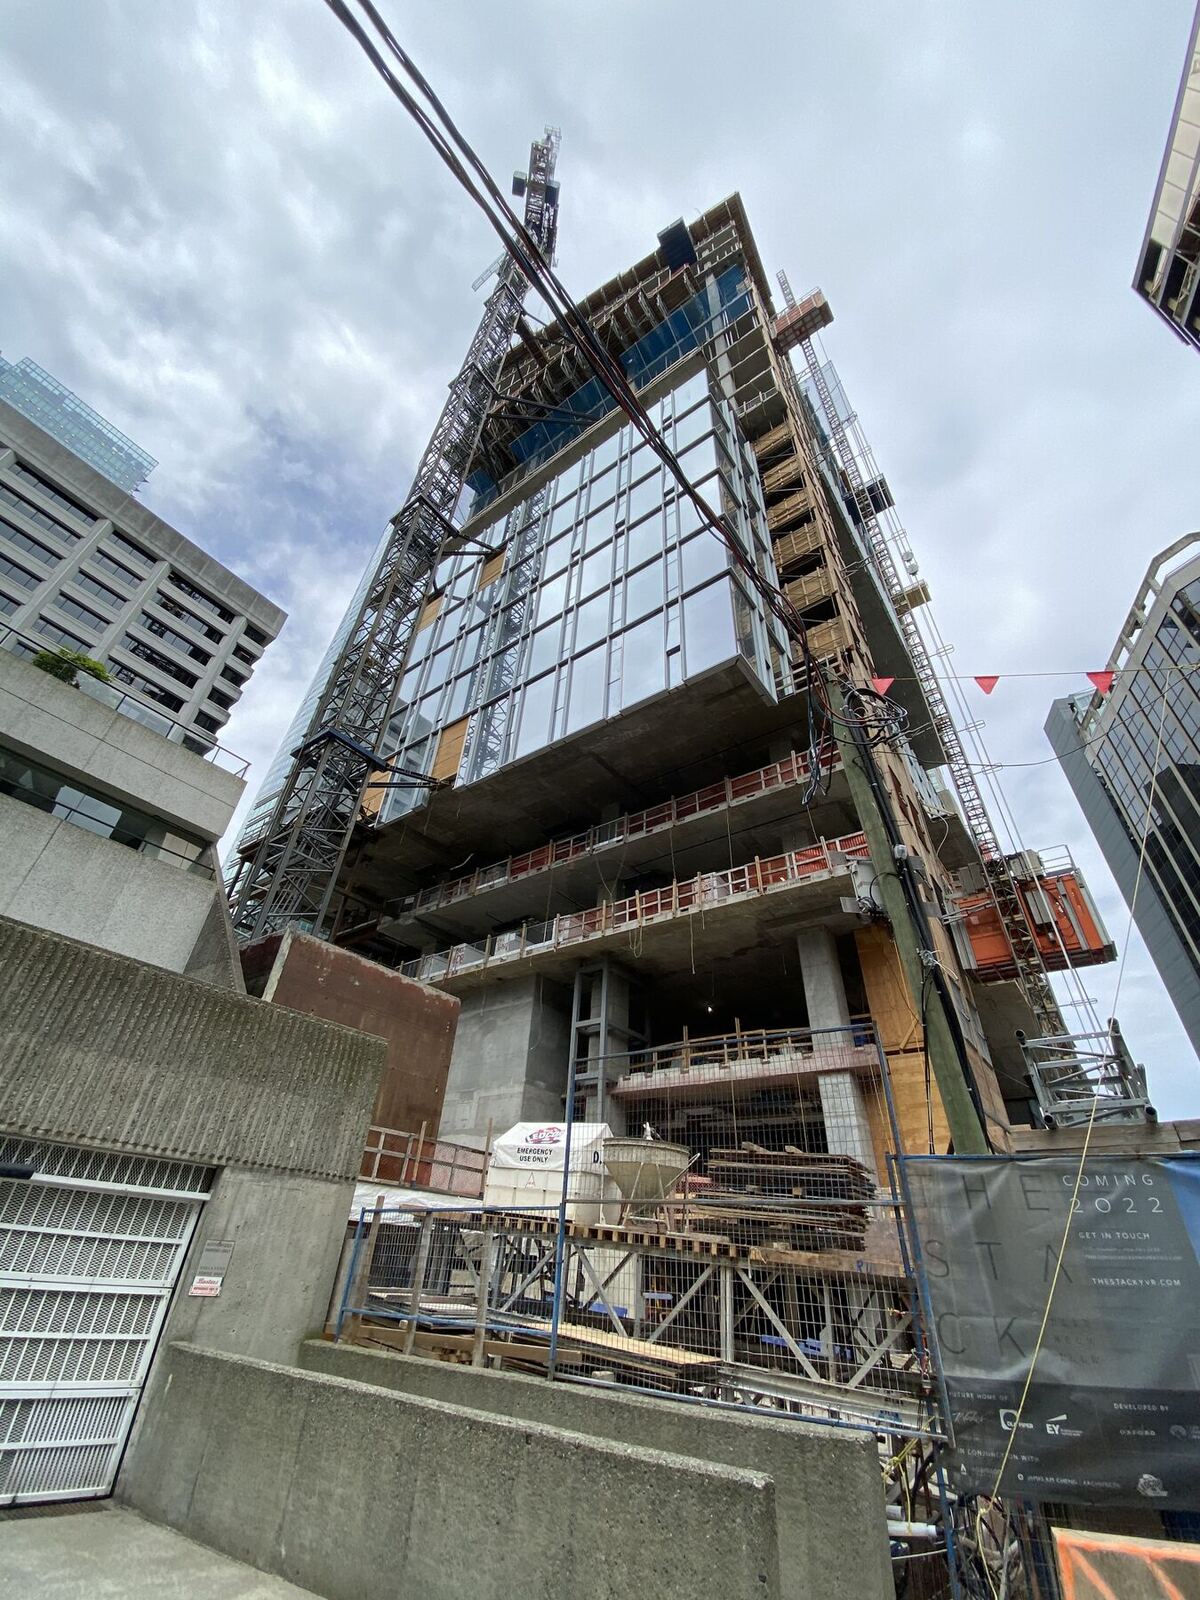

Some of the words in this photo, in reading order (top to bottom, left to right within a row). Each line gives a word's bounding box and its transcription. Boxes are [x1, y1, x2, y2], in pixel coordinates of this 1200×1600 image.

[517, 1147, 553, 1156] EMERGENCY
[1062, 1174, 1153, 1187] COMING
[1069, 1197, 1164, 1214] 2022
[1078, 1232, 1097, 1240] GET
[1101, 1232, 1112, 1240] IN
[1116, 1231, 1150, 1240] TOUCH
[1046, 1423, 1059, 1434] EY
